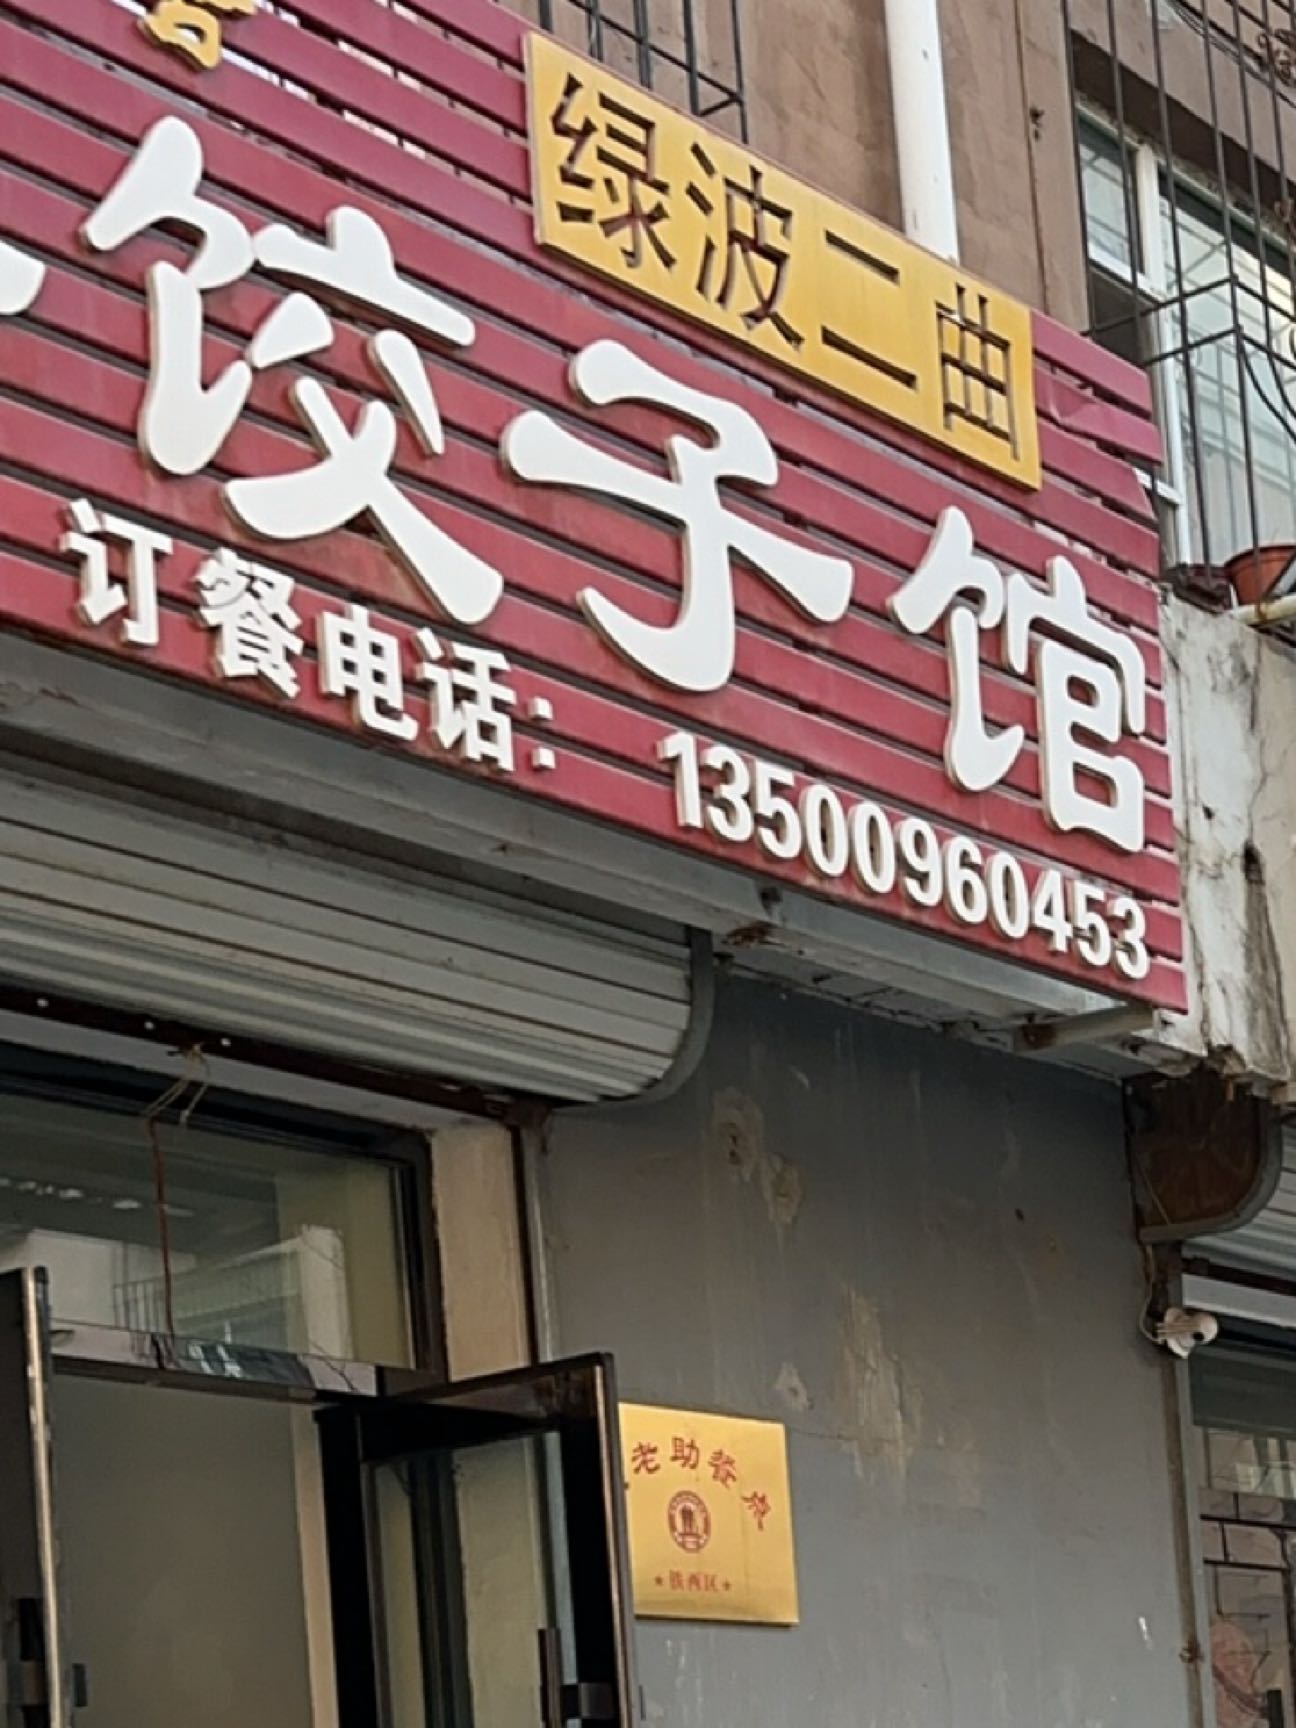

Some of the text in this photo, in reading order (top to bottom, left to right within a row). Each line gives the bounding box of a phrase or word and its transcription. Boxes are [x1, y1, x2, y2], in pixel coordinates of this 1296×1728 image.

[549, 72, 1022, 462] 绿波二曲
[0, 115, 1147, 854] 饺子馆
[655, 730, 1153, 982] 13500960453
